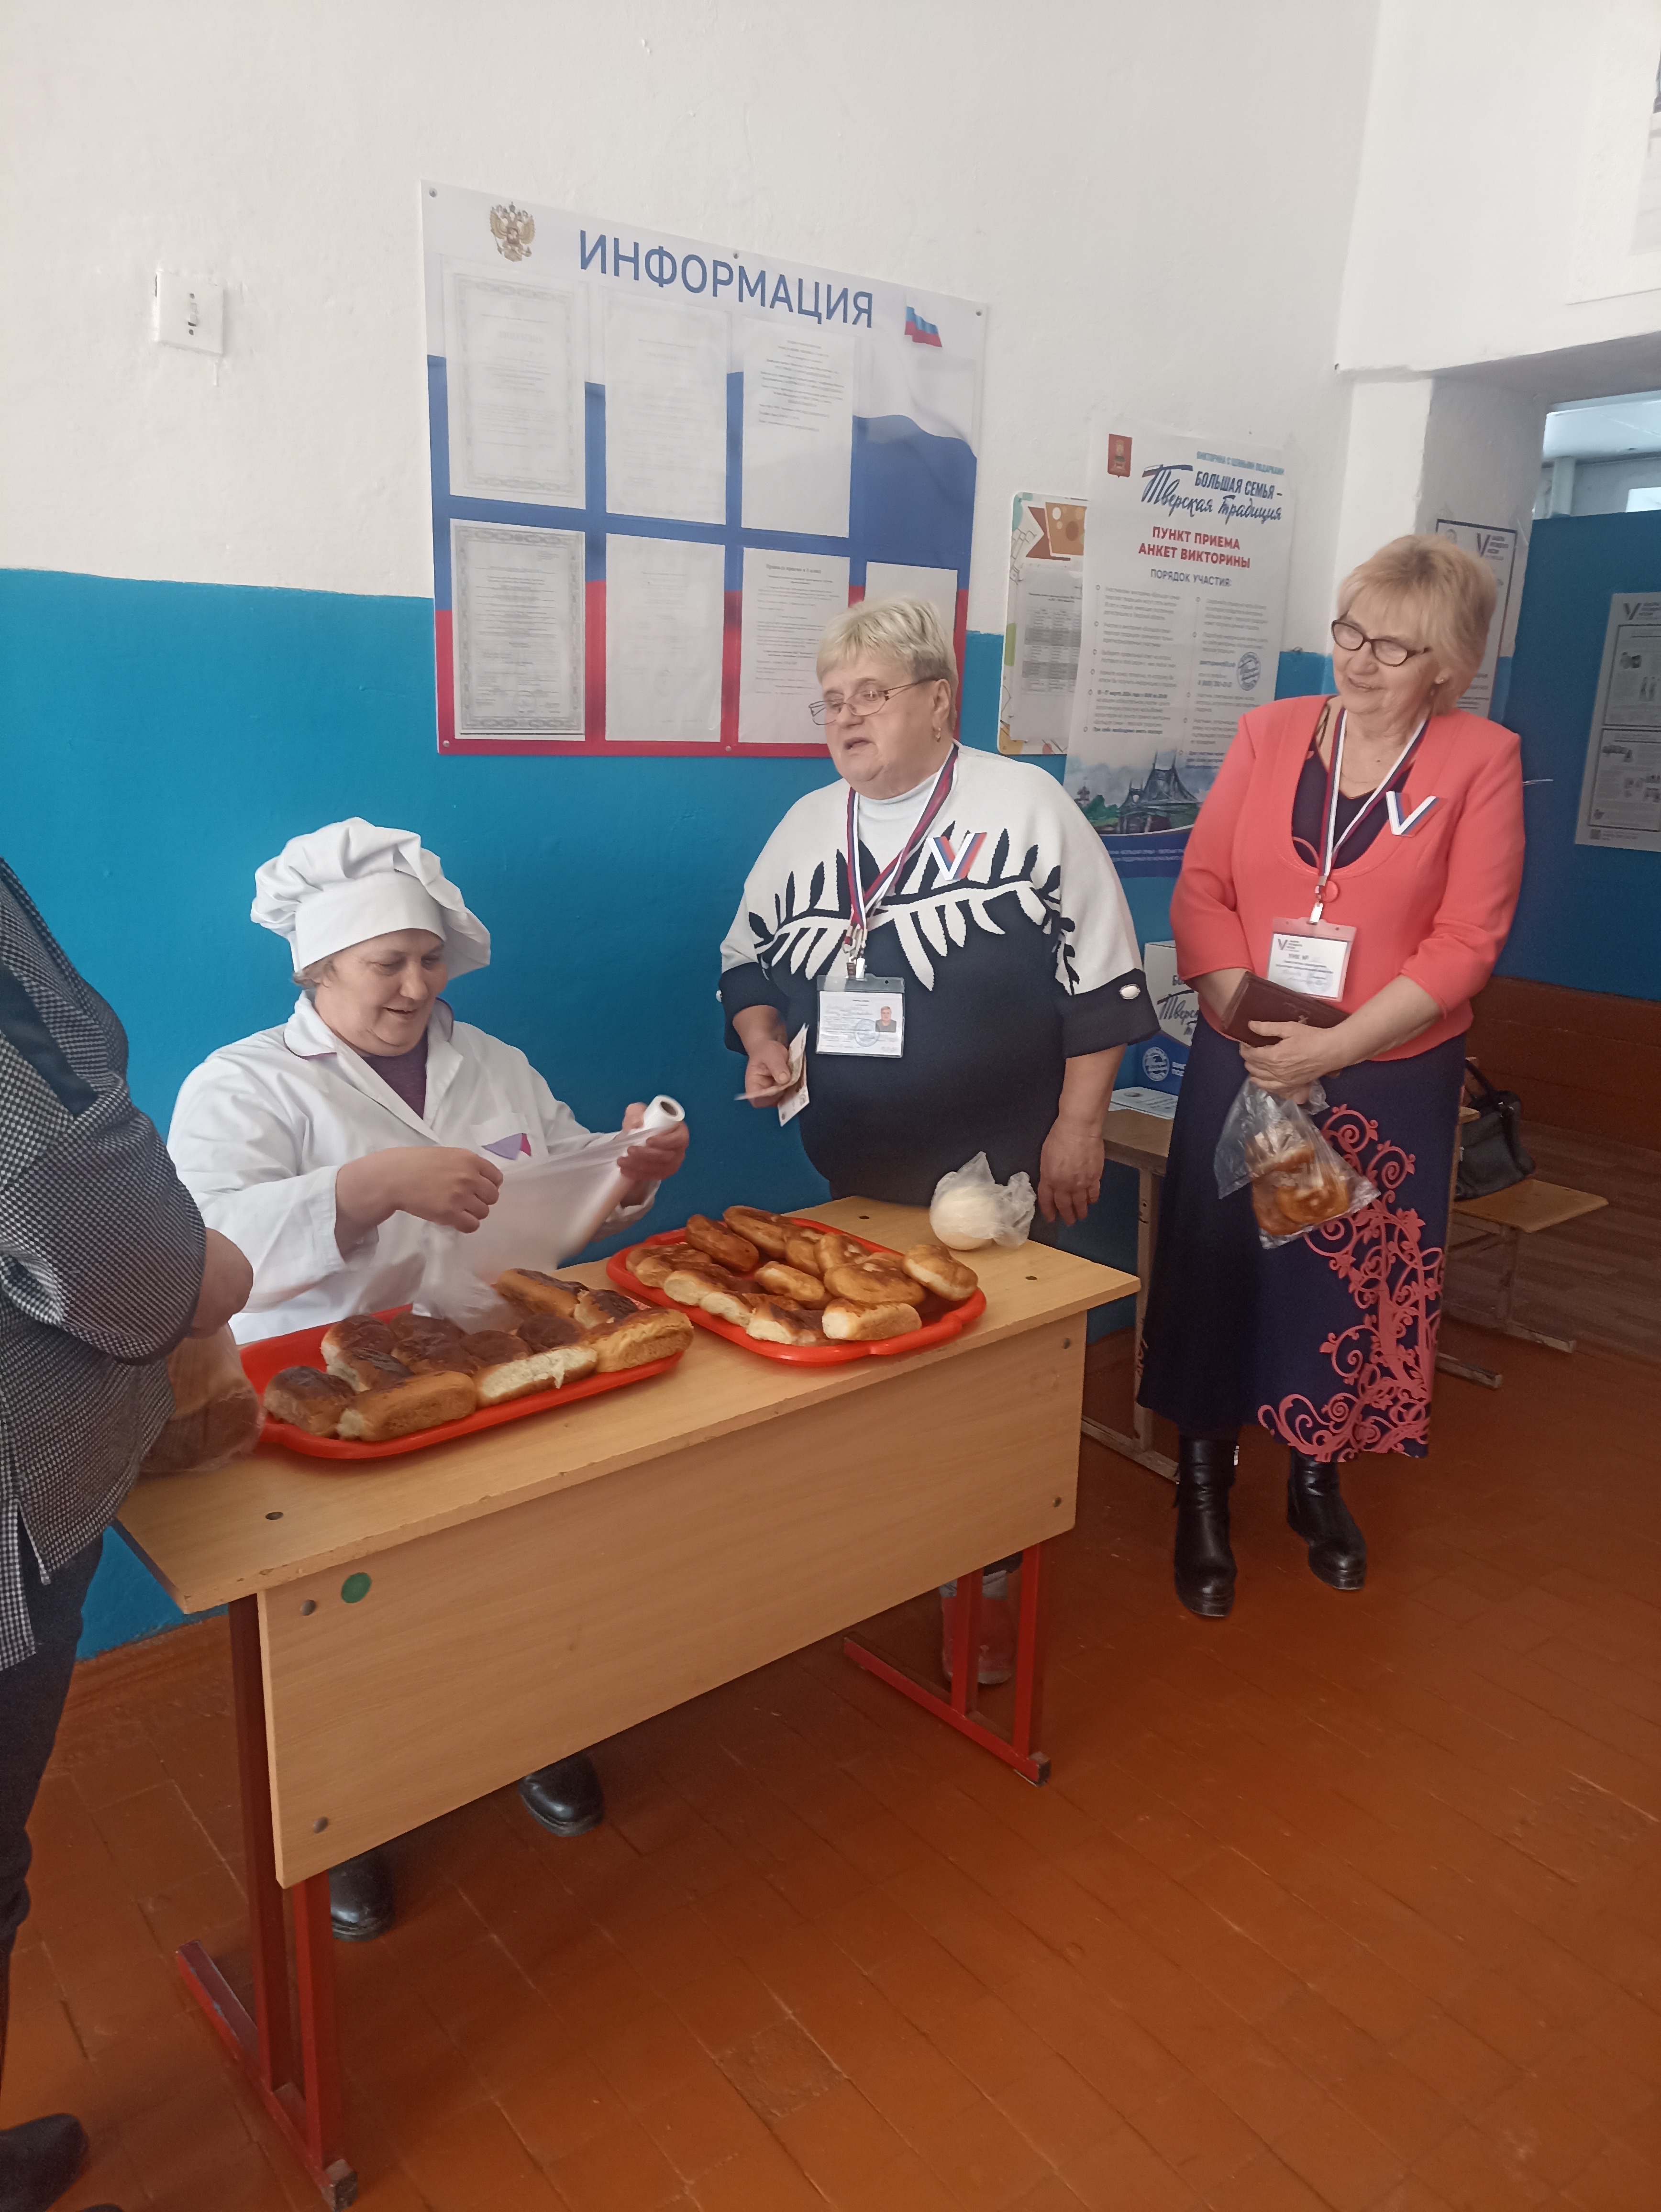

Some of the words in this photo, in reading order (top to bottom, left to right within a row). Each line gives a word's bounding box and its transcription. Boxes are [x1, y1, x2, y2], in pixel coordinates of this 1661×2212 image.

[580, 230, 873, 328] ИНФОРМАЦИЯ
[1141, 465, 1213, 517] Тверская
[1195, 471, 1243, 493] БОЛЬШАЯ
[1245, 481, 1275, 499] СЕМЬЯ
[1152, 526, 1191, 542] ПУНКТ
[1194, 533, 1240, 550] ПРИЕМА
[1138, 543, 1178, 558] АНКЕТ
[1181, 548, 1250, 568] ВИКТОРИНЫ
[1151, 569, 1190, 583] ПОРЯДОК
